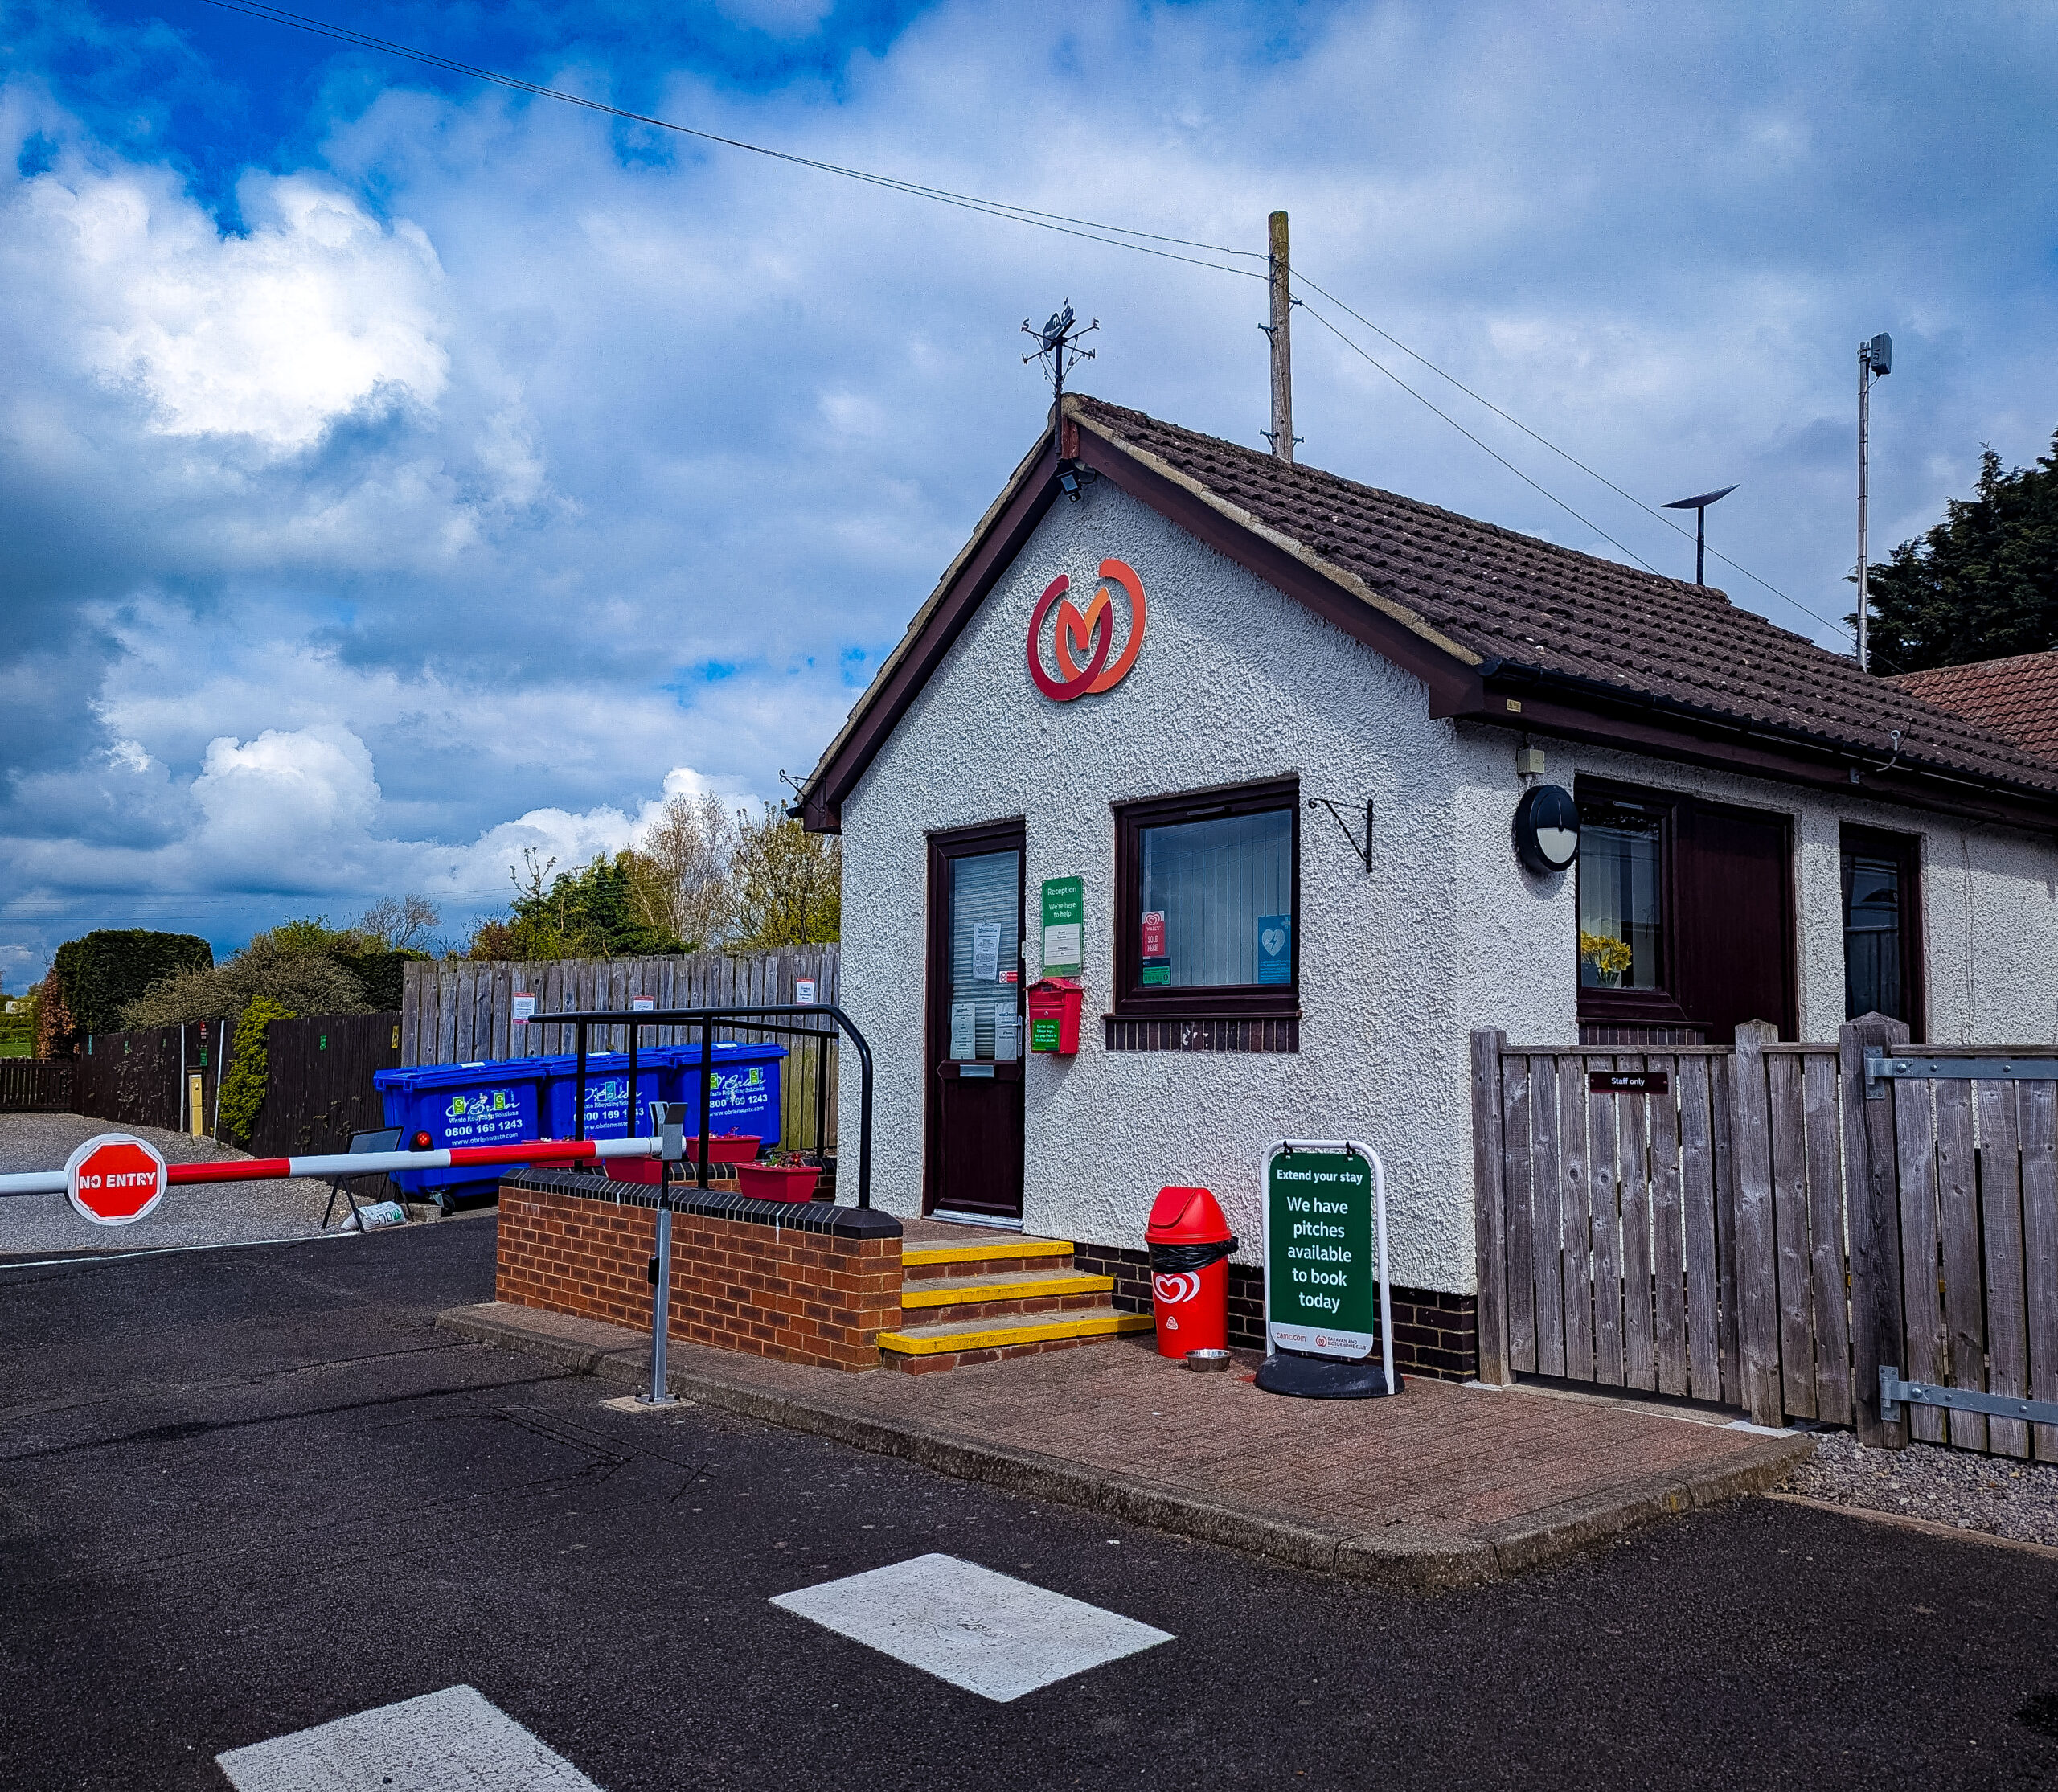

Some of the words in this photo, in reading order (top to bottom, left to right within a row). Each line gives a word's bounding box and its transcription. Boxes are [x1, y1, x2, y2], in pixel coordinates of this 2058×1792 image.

[1047, 886, 1077, 896] Reception
[1060, 910, 1072, 918] help
[1147, 936, 1159, 944] SOLD
[1611, 1077, 1629, 1085] Staff
[1629, 1077, 1646, 1087] only
[748, 1094, 768, 1104] 1243
[494, 1111, 519, 1119] Solutions
[601, 1109, 620, 1120] 169
[445, 1126, 473, 1138] 0800
[476, 1123, 495, 1134] 169
[498, 1119, 523, 1130] 1243
[451, 1132, 519, 1146] www.obrienwaste.com
[80, 1175, 102, 1189] NO
[106, 1171, 156, 1188] ENTRY
[1277, 1169, 1312, 1181] Extend
[1314, 1172, 1338, 1184] your
[1339, 1171, 1363, 1186] stay
[1286, 1196, 1310, 1212] We
[1314, 1197, 1348, 1214] have
[1293, 1220, 1345, 1239] pitches
[1287, 1244, 1352, 1262] available
[1292, 1267, 1307, 1282] to
[1310, 1268, 1347, 1286] book
[1298, 1291, 1340, 1314] today
[1276, 1332, 1306, 1343] camc.com
